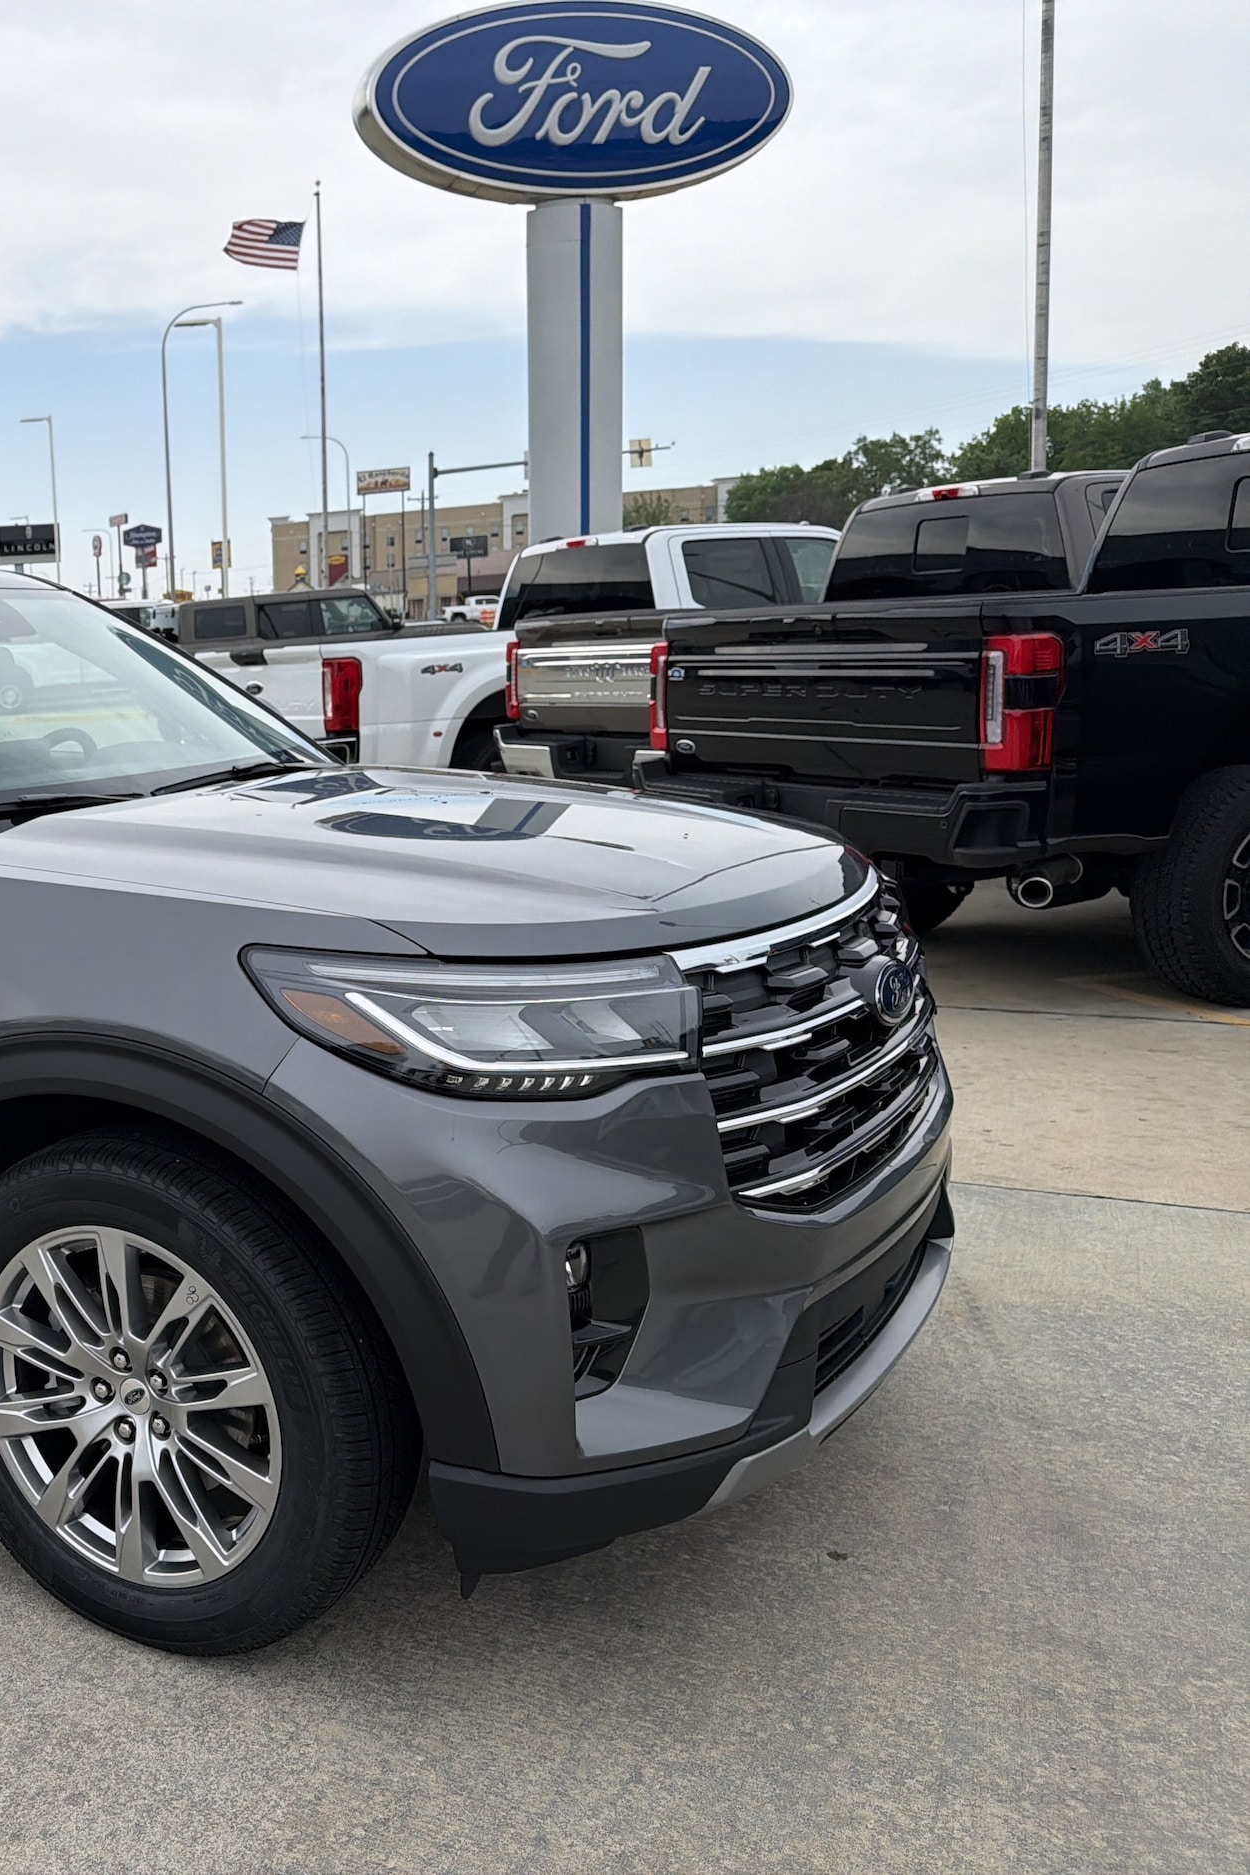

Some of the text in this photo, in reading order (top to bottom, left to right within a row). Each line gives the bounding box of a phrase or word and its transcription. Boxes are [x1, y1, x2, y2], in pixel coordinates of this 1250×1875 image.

[468, 34, 712, 147] Ford
[3, 542, 55, 553] LINCOLN
[697, 684, 922, 699] SUPER DUTY
